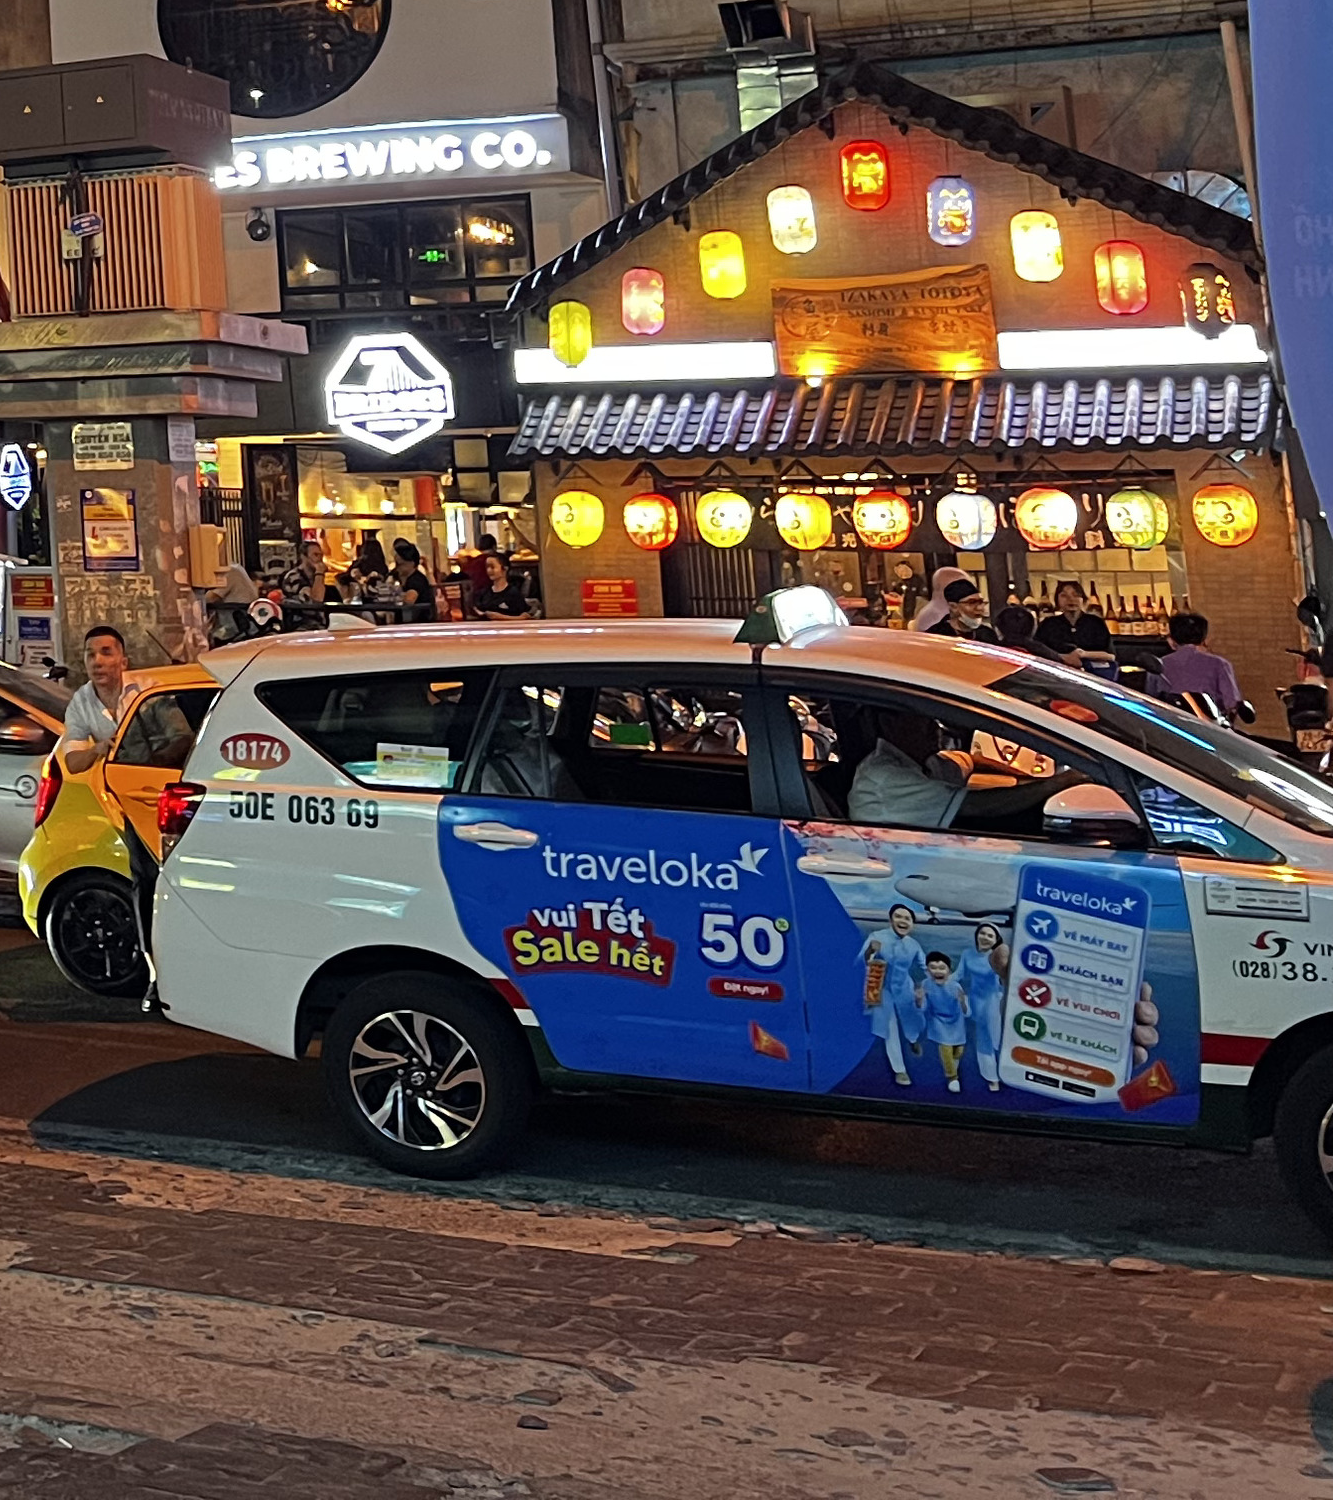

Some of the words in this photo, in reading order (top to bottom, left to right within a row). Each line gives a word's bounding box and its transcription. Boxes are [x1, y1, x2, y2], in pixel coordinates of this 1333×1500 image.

[265, 133, 465, 184] BREWING
[469, 129, 552, 171] CO.
[224, 739, 284, 763] 18174
[229, 790, 275, 821] 50E
[288, 794, 335, 826] 063
[346, 798, 380, 829] 69
[542, 844, 740, 891] traveloka
[1036, 878, 1124, 917] traveloka
[532, 902, 579, 929] vui
[583, 896, 645, 939] Tết
[511, 929, 600, 966] Sale
[608, 941, 665, 977] hết
[1233, 959, 1278, 980] (028)
[1058, 961, 1099, 982] KHÁCH
[1100, 973, 1125, 989] SẠN
[1072, 1001, 1092, 1014] VUI
[1064, 1032, 1080, 1046] XE
[1080, 1035, 1118, 1056] KHÁCH
